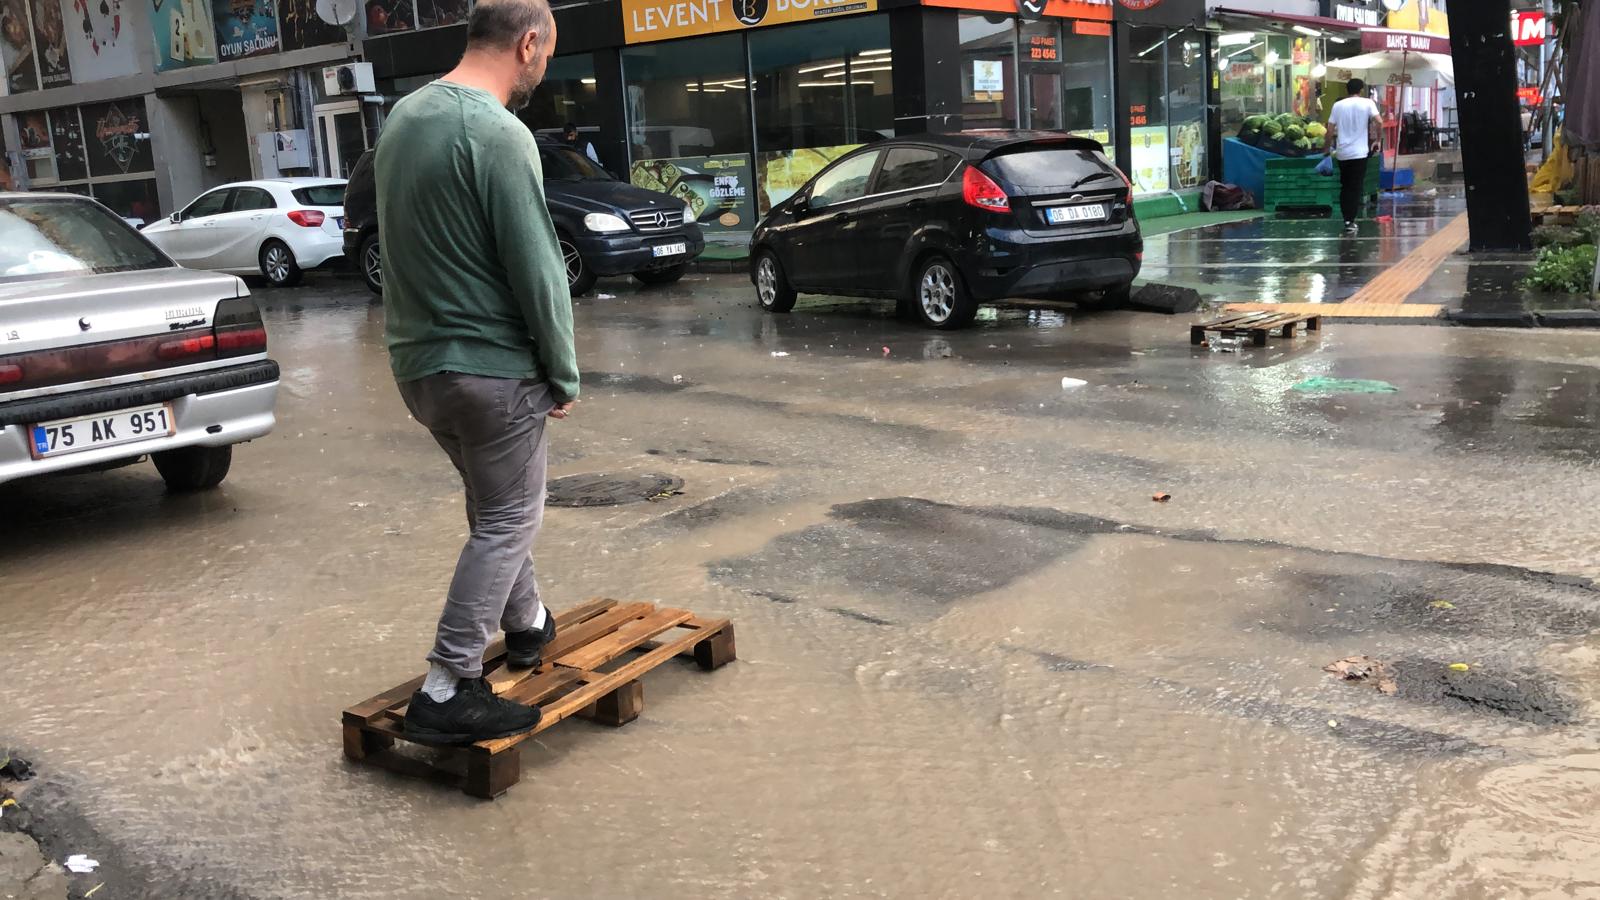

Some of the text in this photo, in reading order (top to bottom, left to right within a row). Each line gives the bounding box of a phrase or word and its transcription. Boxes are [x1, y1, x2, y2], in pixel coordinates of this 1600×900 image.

[633, 0, 724, 32] LEVENT
[1510, 10, 1546, 41] İM
[220, 35, 278, 57] OYUN SALONU
[1410, 36, 1431, 50] MANAV
[709, 187, 746, 198] GÖZLEME
[1053, 205, 1103, 221] 06 DA 0180
[46, 424, 75, 450] 75
[92, 418, 116, 442] AK
[130, 409, 167, 434] 951
